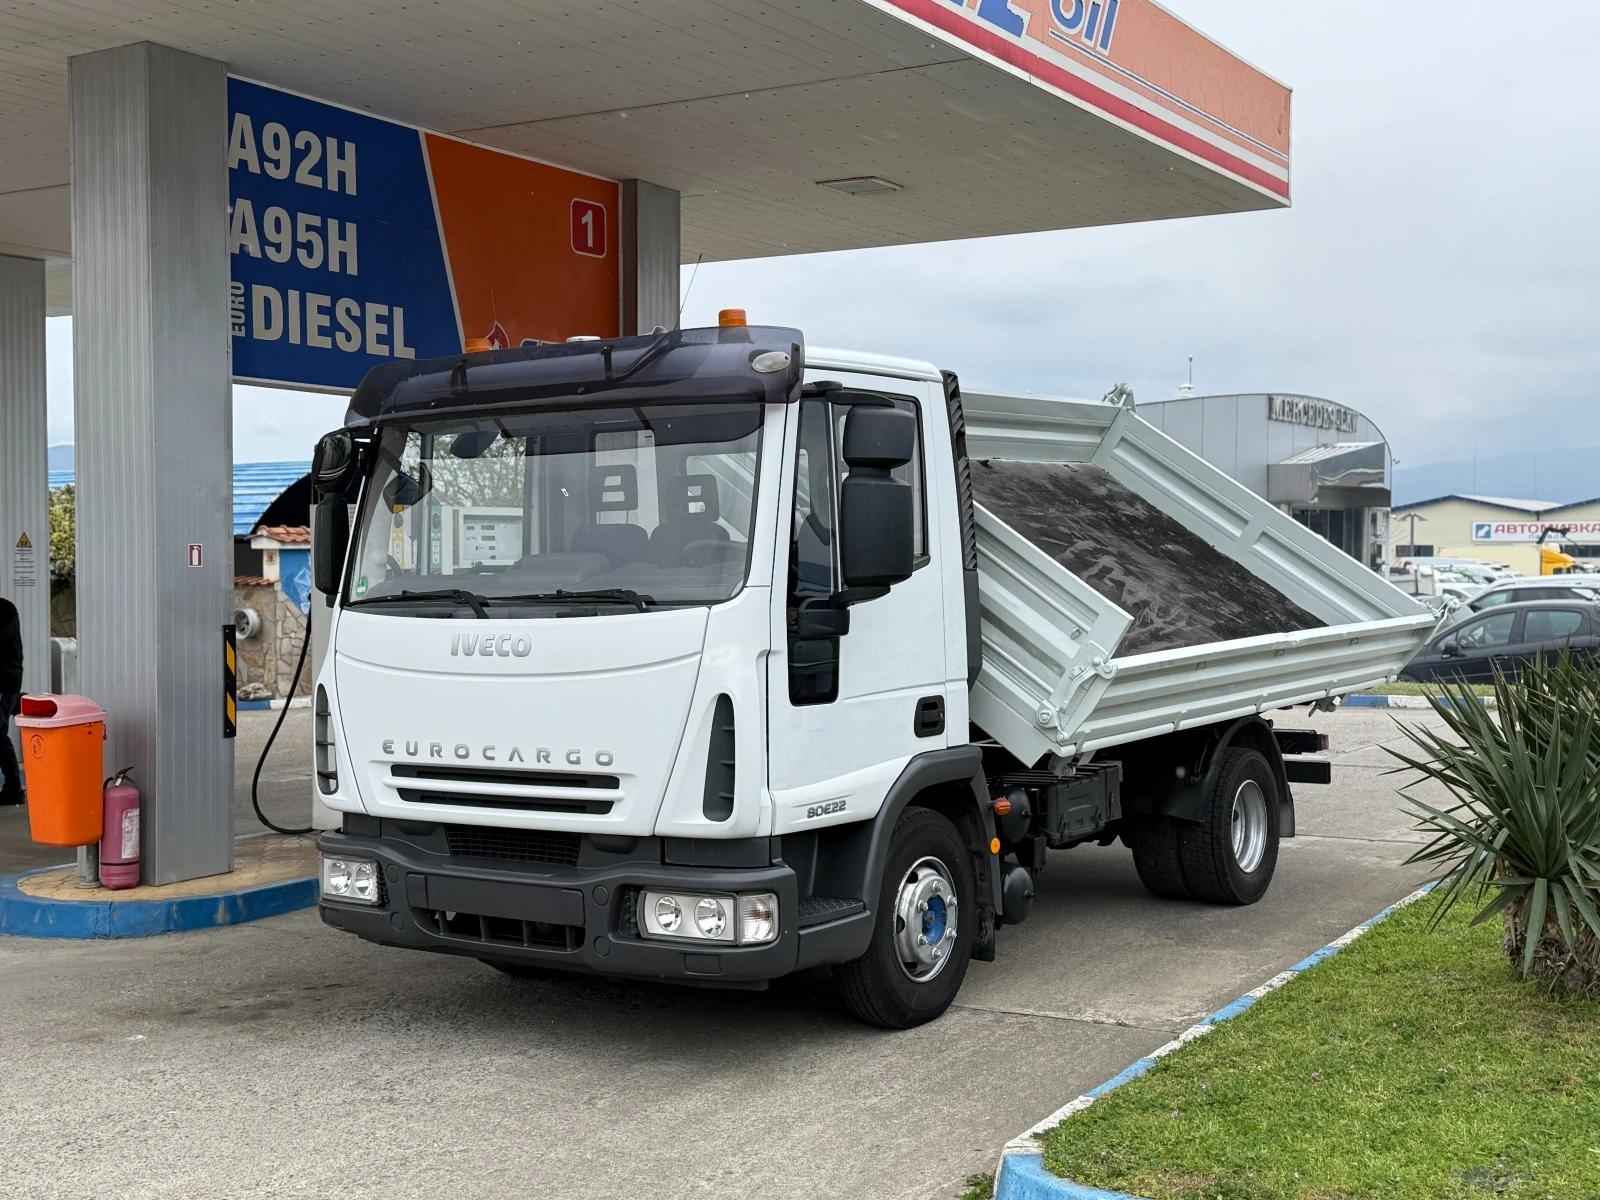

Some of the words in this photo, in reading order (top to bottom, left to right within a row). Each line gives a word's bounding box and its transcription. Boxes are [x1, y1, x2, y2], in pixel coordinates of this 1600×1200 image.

[228, 112, 357, 196] A92H
[230, 197, 358, 276] A95H
[581, 210, 593, 248] 1
[231, 281, 246, 337] EURO
[251, 283, 416, 360] DIESEL
[450, 633, 532, 658] IVECO
[382, 739, 614, 767] EUROCARGO
[806, 799, 847, 819] 80E22
